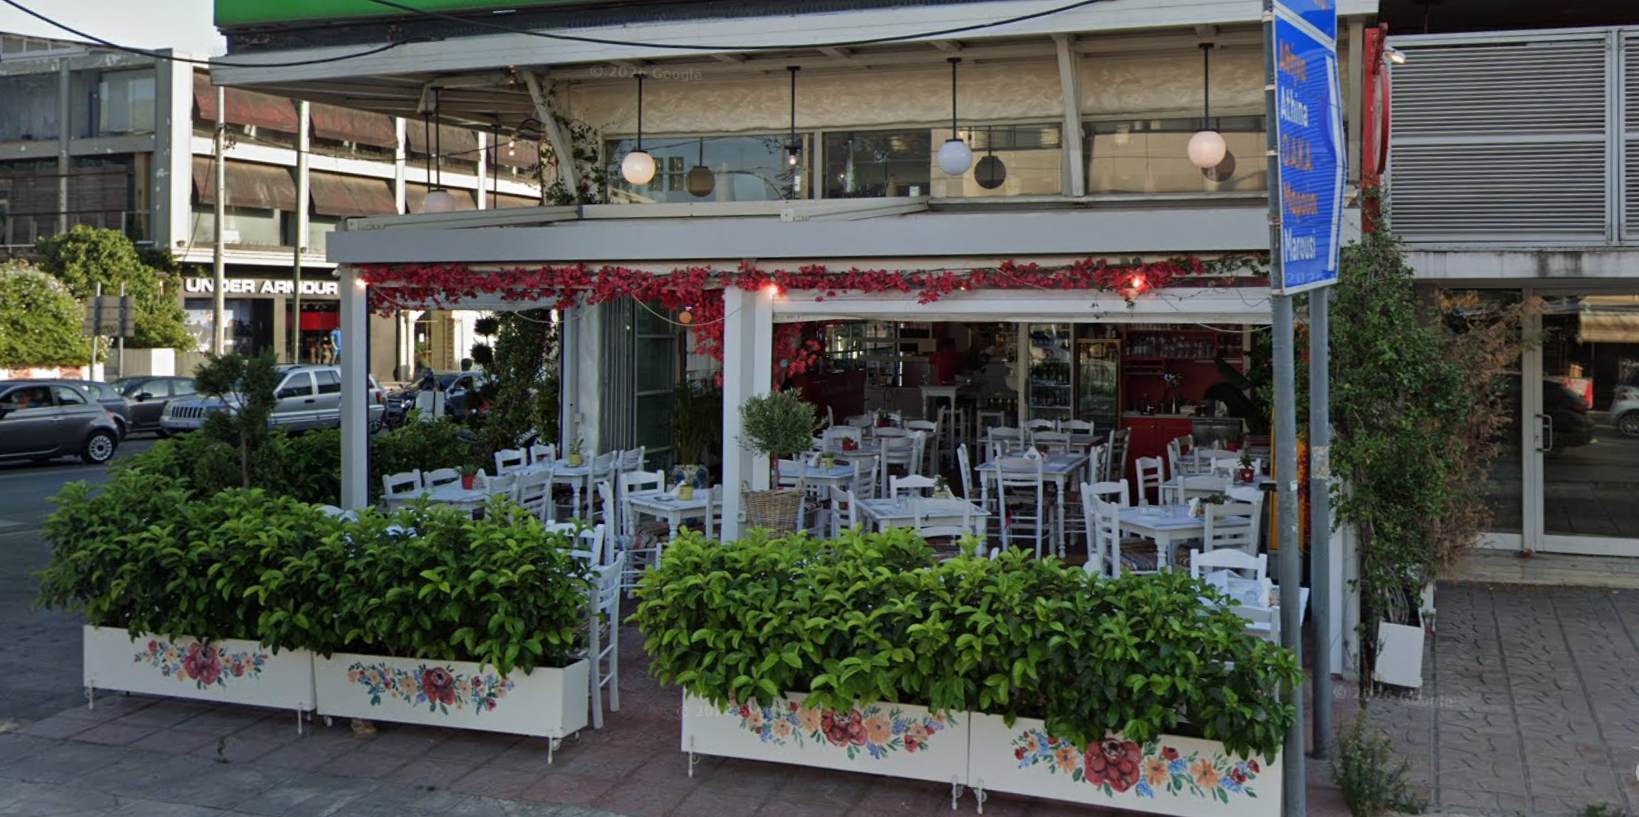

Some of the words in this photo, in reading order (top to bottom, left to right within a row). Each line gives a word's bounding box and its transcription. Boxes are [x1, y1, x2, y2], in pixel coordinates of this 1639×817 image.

[1281, 86, 1309, 128] Athina
[1285, 228, 1316, 262] Marousi
[260, 279, 338, 295] ARMOUR
